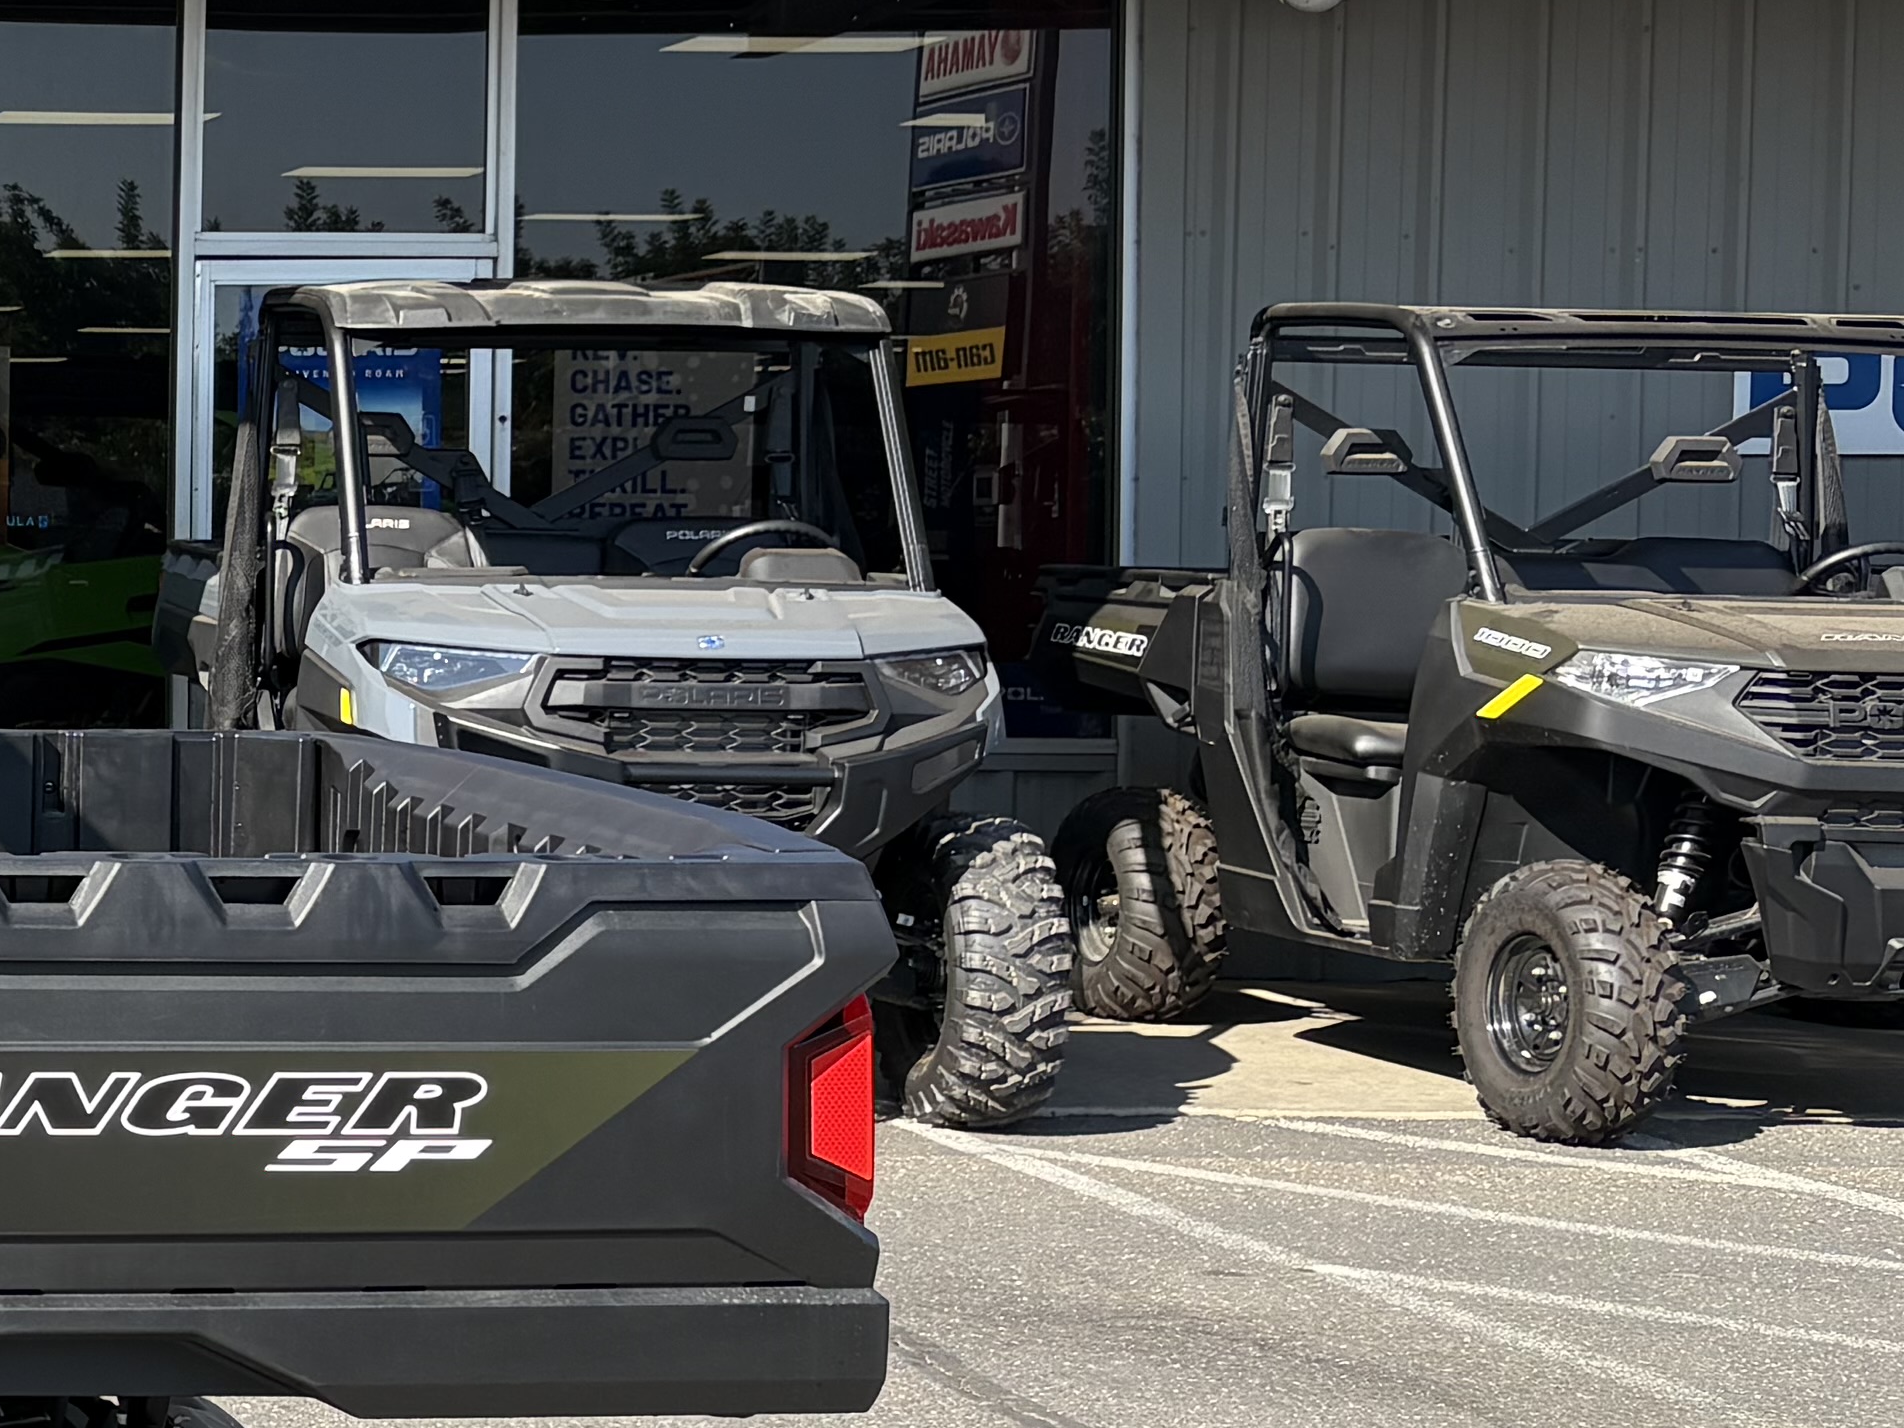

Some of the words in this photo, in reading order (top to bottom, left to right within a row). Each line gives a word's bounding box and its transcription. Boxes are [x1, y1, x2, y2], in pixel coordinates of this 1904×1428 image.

[570, 369, 682, 395] CHASE.
[1050, 623, 1147, 657] RANGER
[1473, 627, 1552, 659] 1000
[641, 685, 785, 707] POLARIS
[263, 1138, 493, 1172] SP
